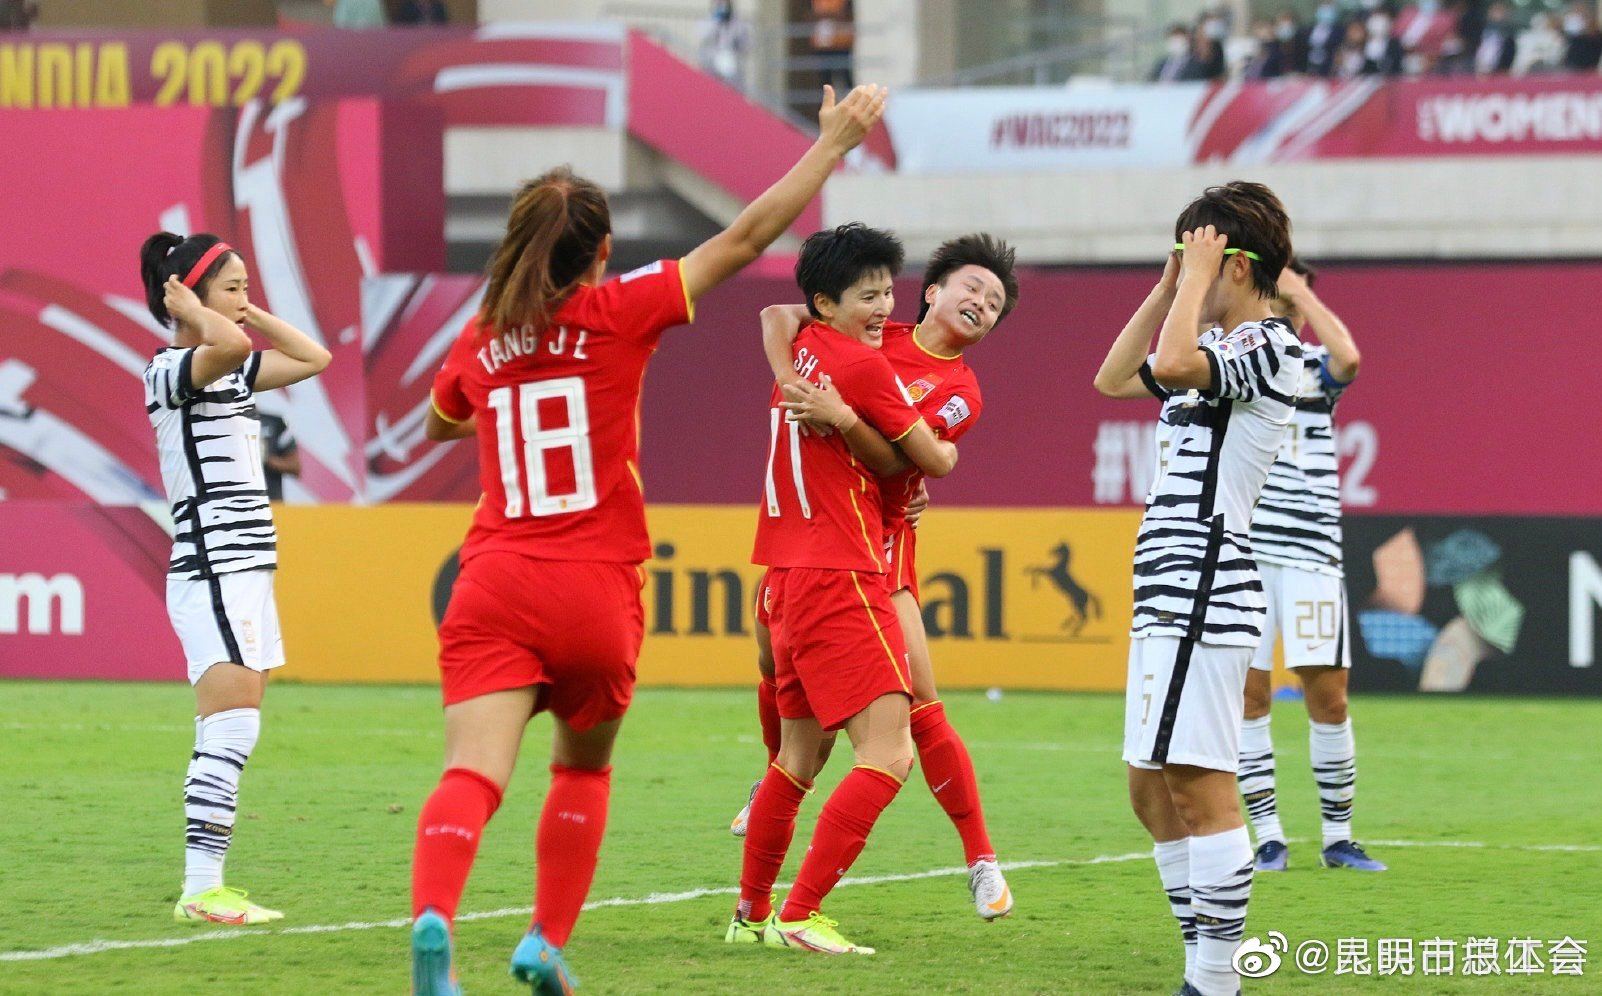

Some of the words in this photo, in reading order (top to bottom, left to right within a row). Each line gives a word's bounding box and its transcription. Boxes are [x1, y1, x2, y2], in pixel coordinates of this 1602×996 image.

[152, 40, 306, 107] 2022
[477, 324, 538, 374] TANG
[487, 376, 598, 518] 18
[1295, 601, 1336, 640] 20
